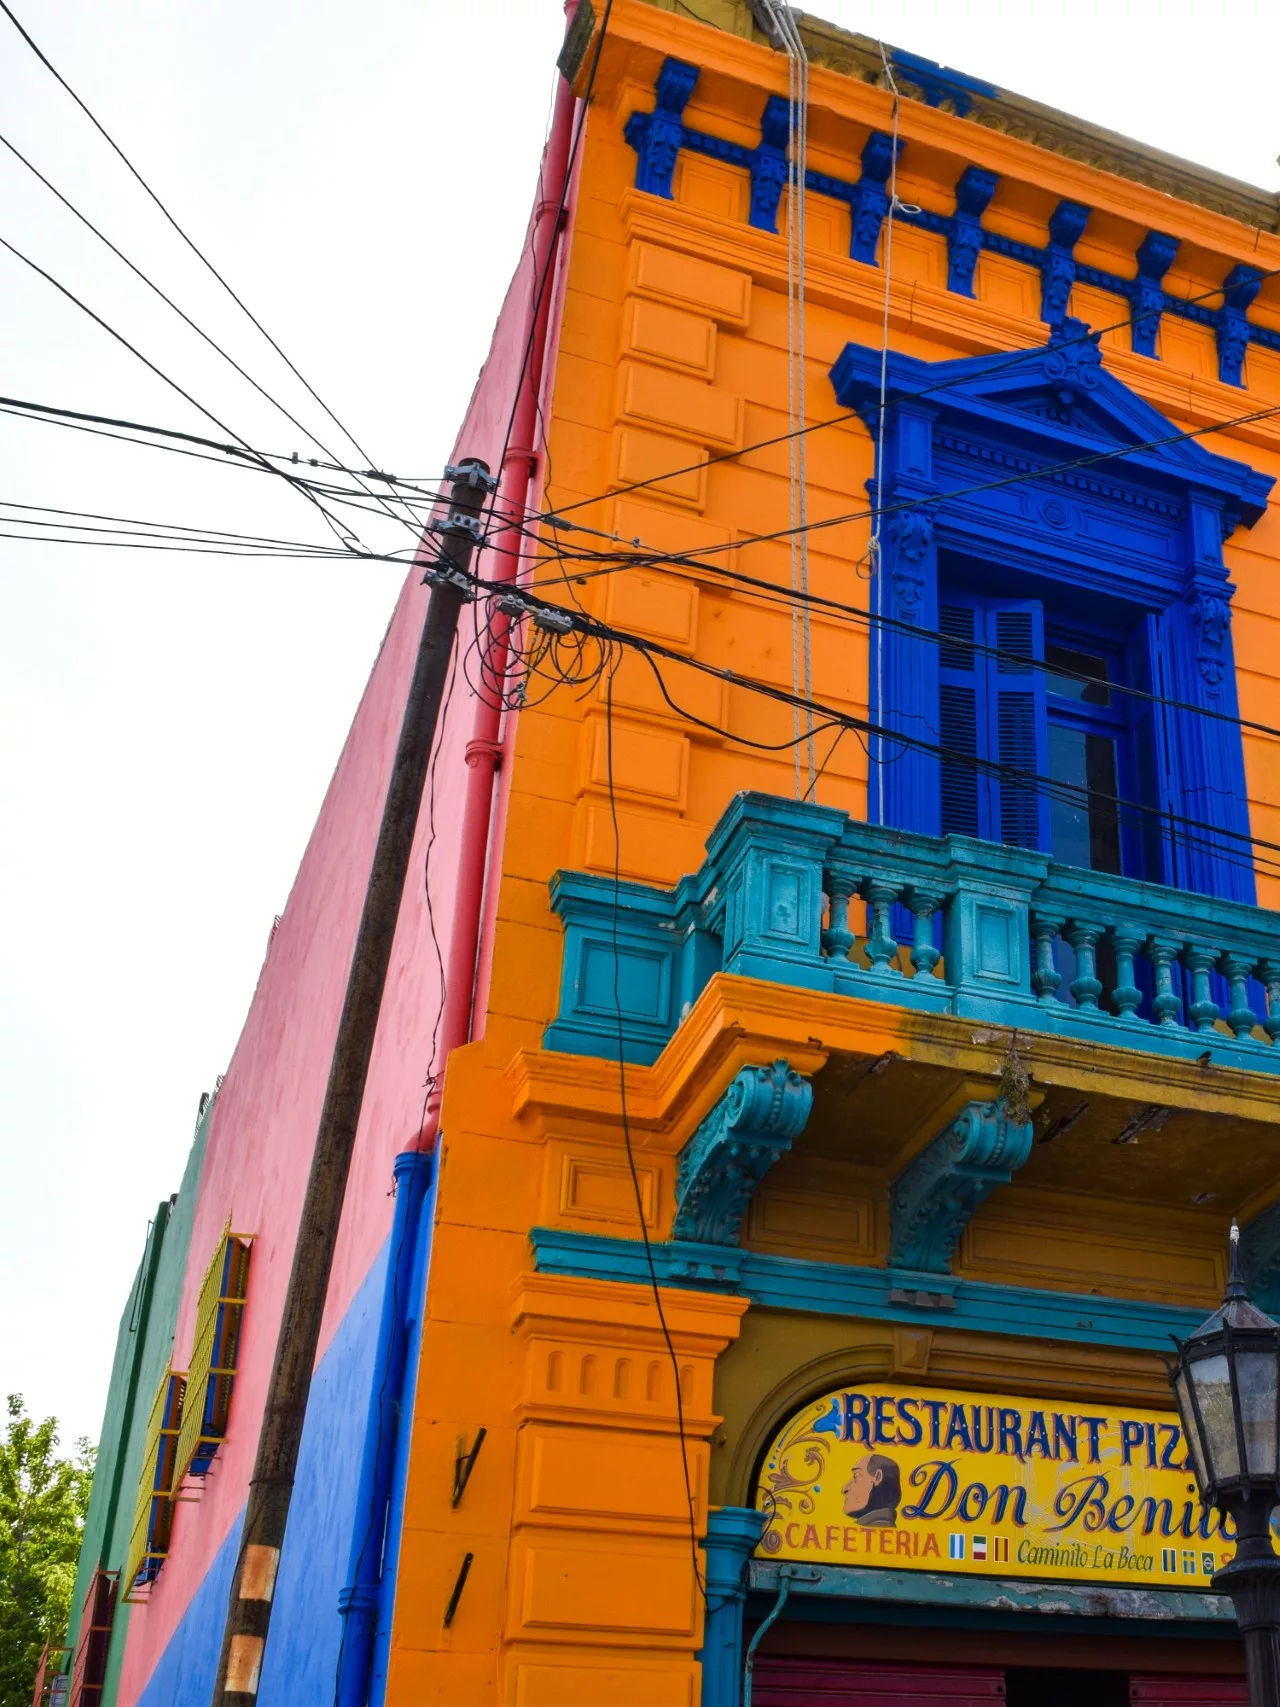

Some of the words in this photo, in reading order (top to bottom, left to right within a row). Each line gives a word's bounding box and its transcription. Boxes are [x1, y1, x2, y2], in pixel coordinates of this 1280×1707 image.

[840, 1393, 1108, 1464] RESTAURANT
[1120, 1419, 1194, 1473] PIZ
[901, 1458, 1028, 1528] Don
[785, 1522, 941, 1559] CAFETERIA
[1017, 1539, 1089, 1568] Caminito
[1092, 1545, 1113, 1569] La
[1117, 1546, 1154, 1571] Boca
